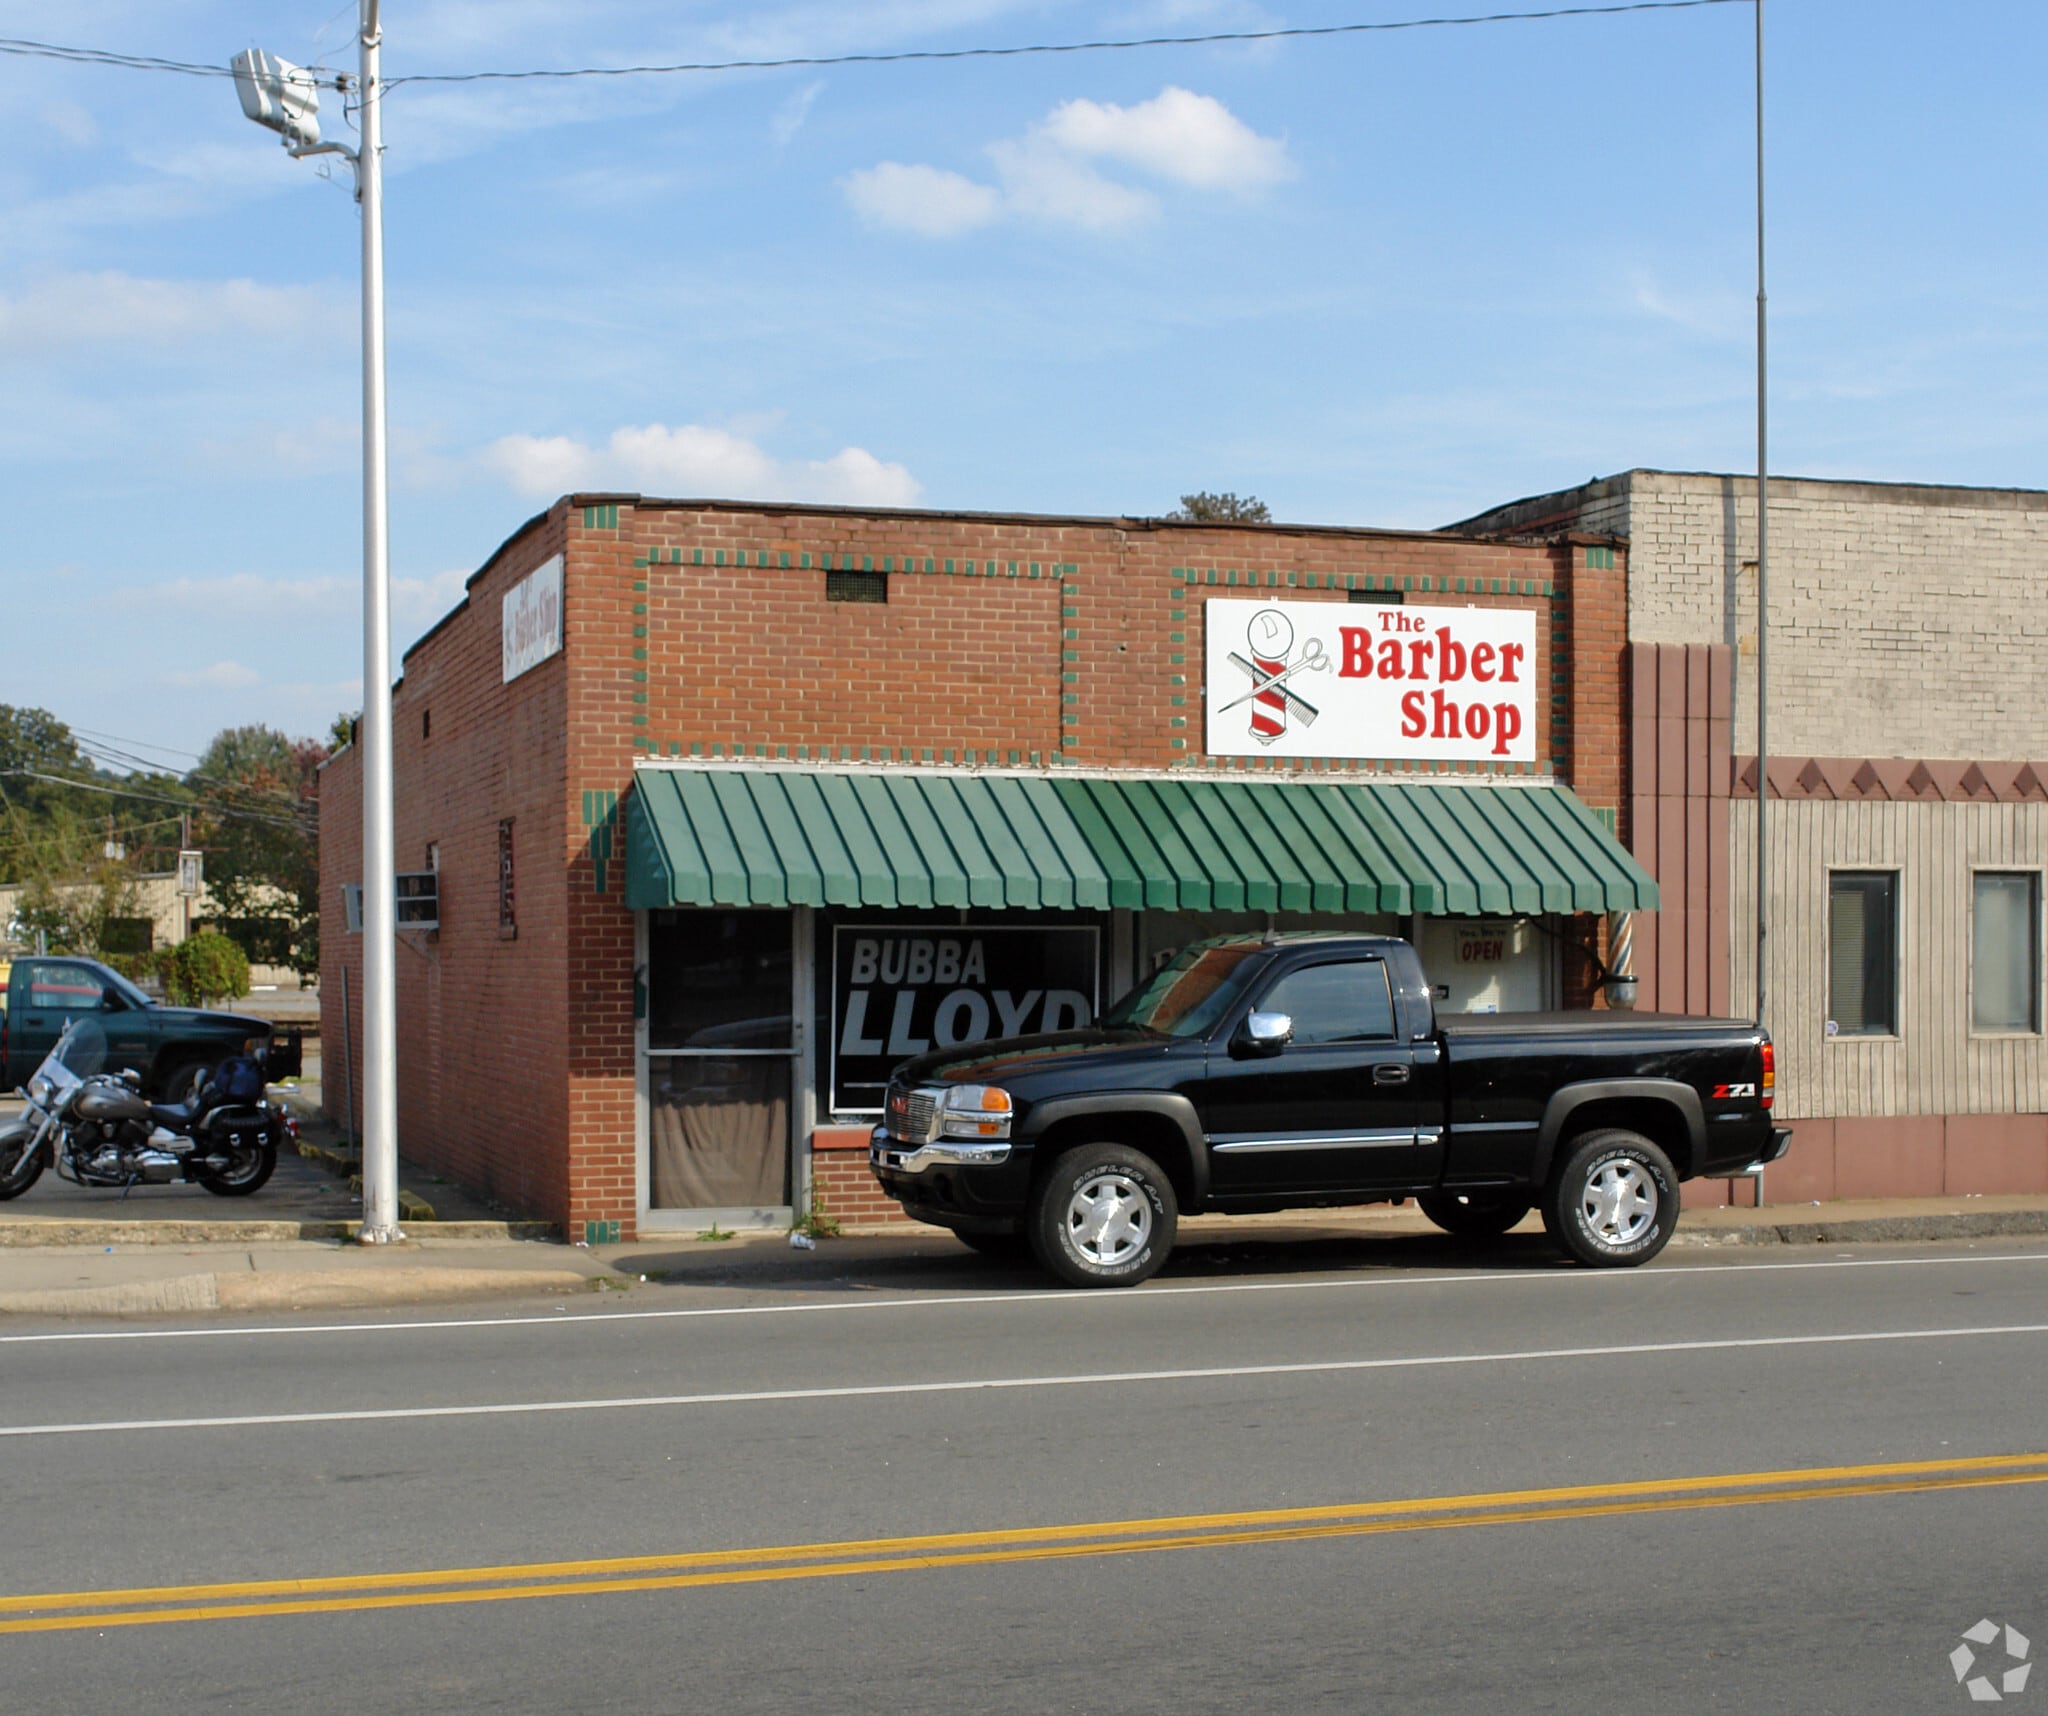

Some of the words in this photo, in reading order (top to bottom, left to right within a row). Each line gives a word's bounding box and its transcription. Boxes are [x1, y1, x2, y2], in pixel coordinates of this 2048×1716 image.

[1378, 611, 1425, 632] The
[1338, 625, 1524, 684] Barber
[1401, 689, 1521, 755] Shop
[850, 938, 986, 984] BUBBA
[1462, 940, 1503, 961] OPEN
[839, 988, 1093, 1056] LLOYD
[1712, 1083, 1756, 1098] Z71
